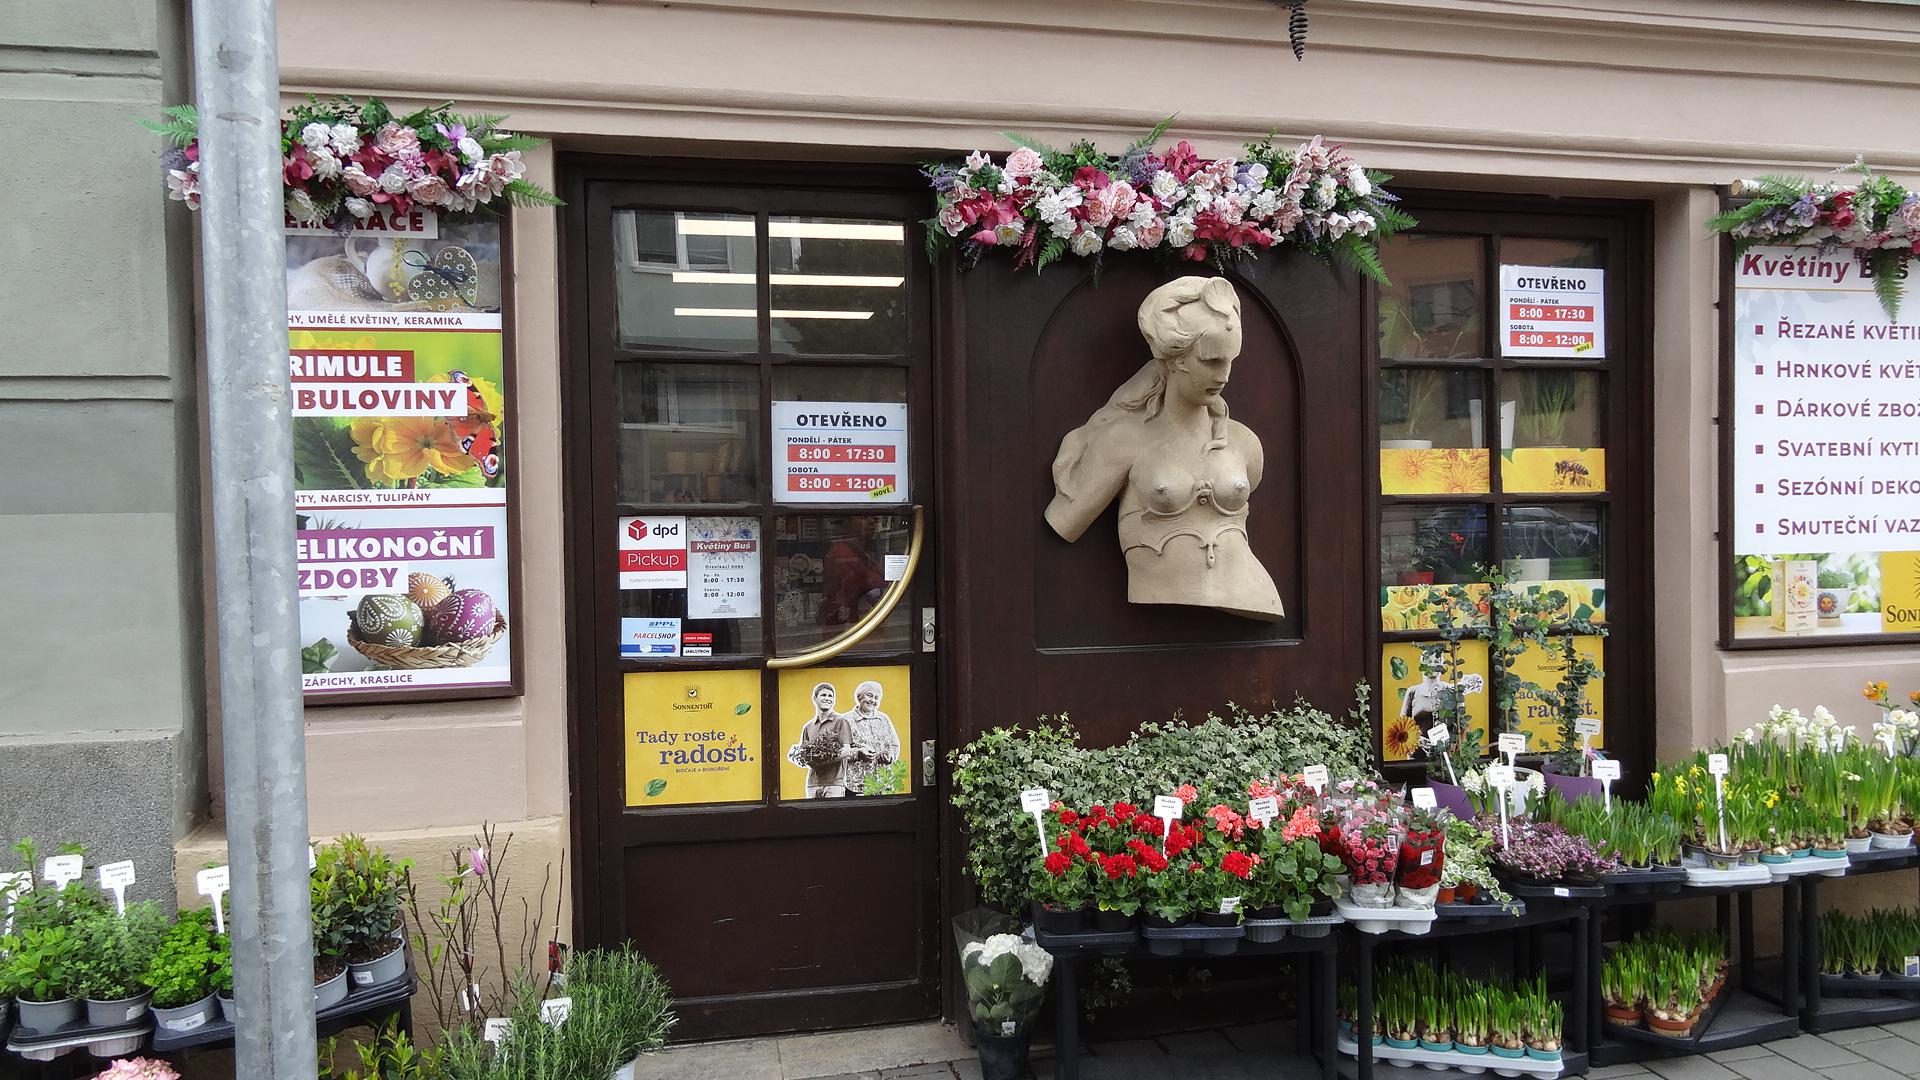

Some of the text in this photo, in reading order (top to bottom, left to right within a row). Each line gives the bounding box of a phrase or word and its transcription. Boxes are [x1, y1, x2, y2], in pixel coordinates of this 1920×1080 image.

[284, 210, 424, 232] EACE
[1742, 253, 1850, 284] Květiny
[1517, 275, 1587, 290] OTEVŘENO
[308, 313, 346, 324] UMĚLÉ
[350, 314, 400, 326] KVĚTINY,
[404, 316, 463, 326] KERAMIKA
[1519, 308, 1543, 318] 8:00
[1554, 309, 1585, 319] 17:30
[1778, 316, 1855, 339] ŘEZANÉ
[1519, 334, 1543, 344] 8:00
[1555, 335, 1585, 345] 12:00
[290, 355, 403, 377] RIMULE
[1777, 359, 1871, 379] HRNKOVÉ
[1777, 398, 1870, 417] DÁRKOVÉ
[796, 411, 888, 428] OTEVŘENO
[828, 436, 852, 444] PÁTEK
[1777, 437, 1872, 457] SVATEBNÍ
[799, 448, 831, 460] 8:00
[846, 448, 885, 460] 17:30
[799, 477, 831, 489] 8:00
[846, 478, 885, 489] 12:00
[1778, 476, 1864, 496] SEZÓNNÍ
[320, 493, 372, 504] NARCISY,
[376, 491, 432, 502] TULIPÁNY
[653, 523, 678, 538] dpd
[1778, 515, 1878, 536] SMUTEČNÍ
[297, 529, 484, 560] ELIKONOČNÍ
[696, 541, 751, 551] Květiny Buš
[627, 553, 679, 568] Pickup
[298, 568, 399, 590] ZDOBY
[304, 673, 413, 688] ZÁPICHY, KRASLICE
[1527, 699, 1598, 718] radst.
[637, 729, 725, 745] Tady roste
[660, 743, 754, 764] radost.
